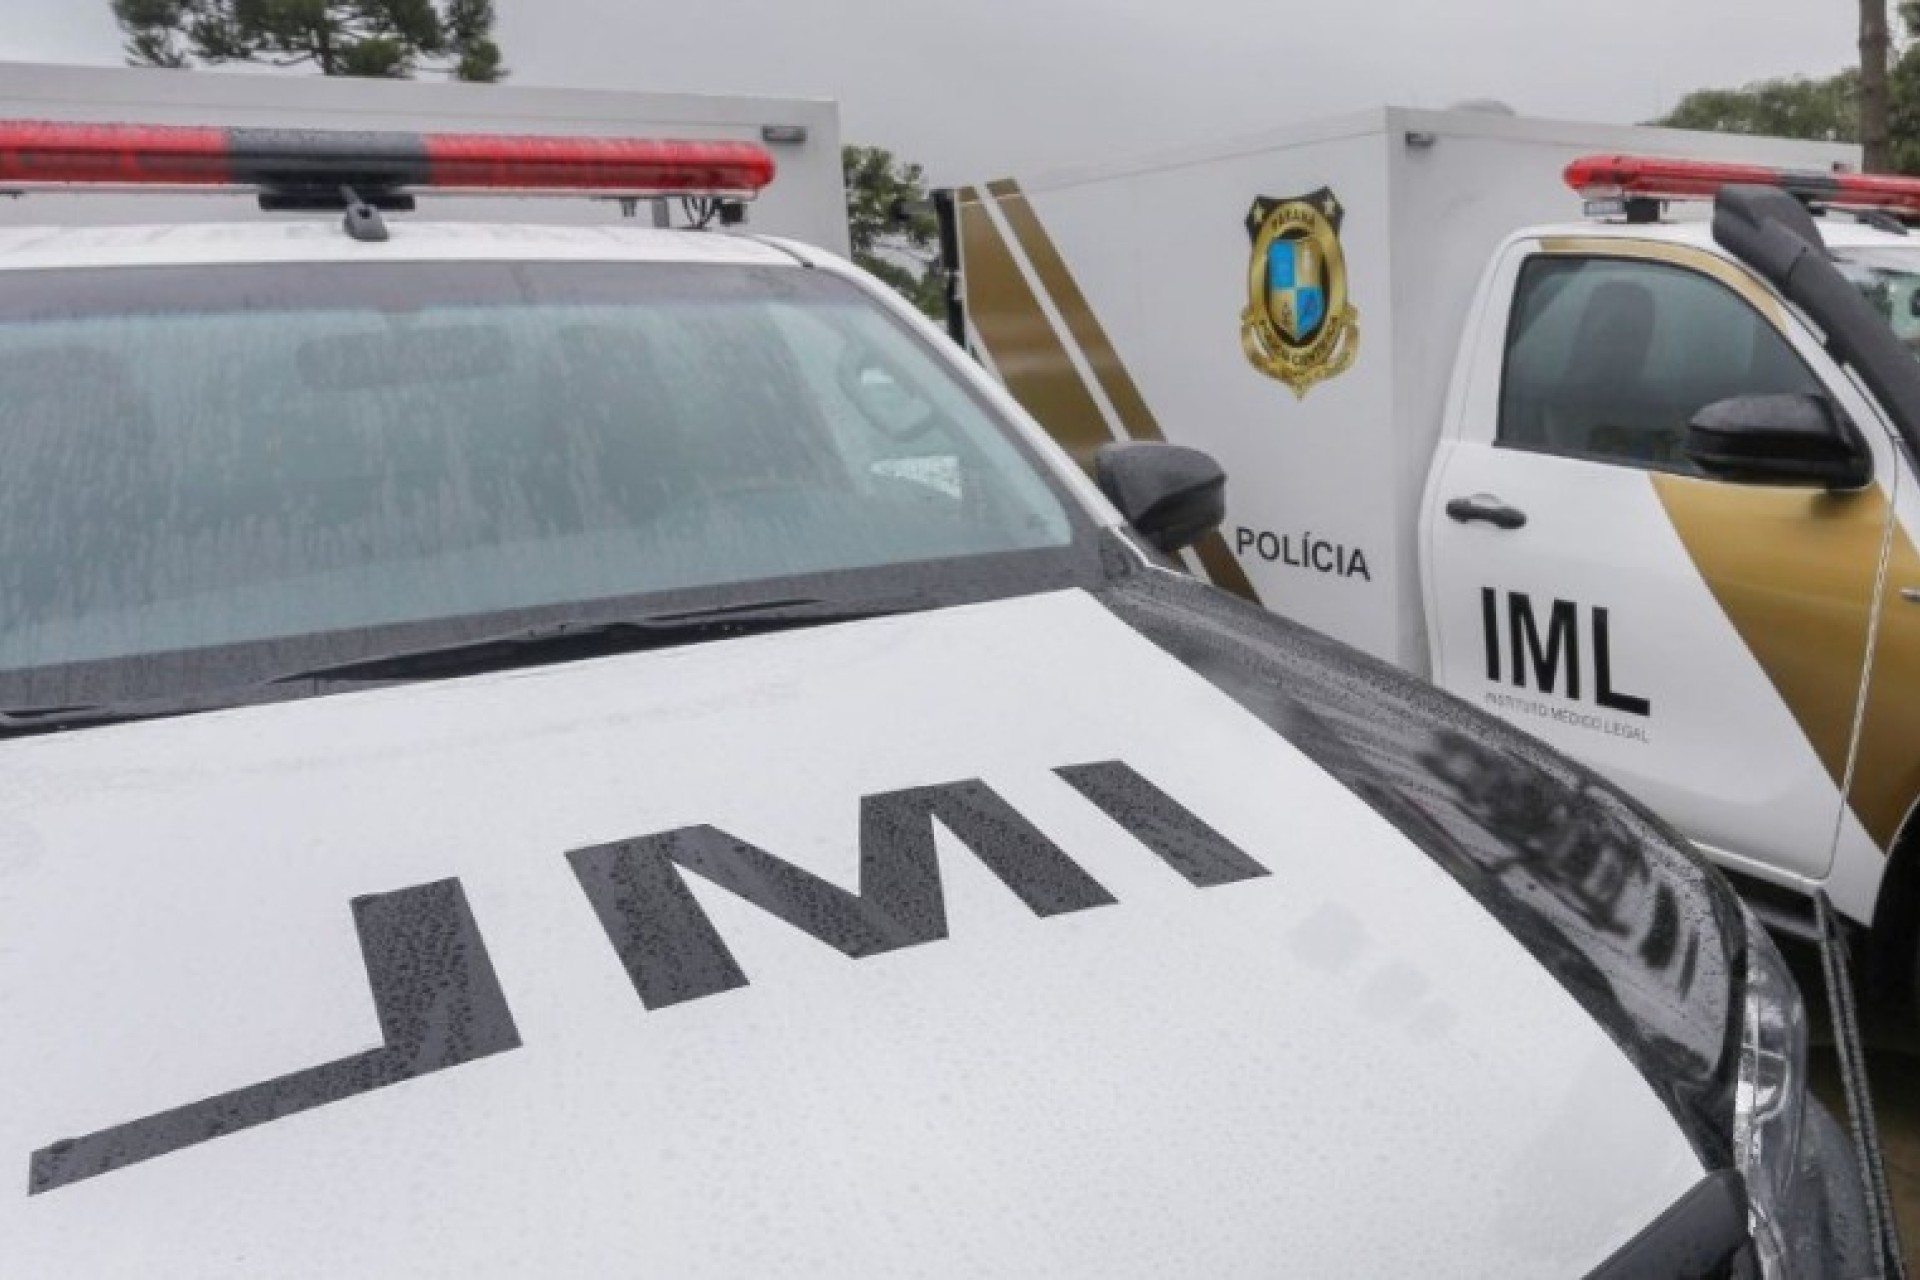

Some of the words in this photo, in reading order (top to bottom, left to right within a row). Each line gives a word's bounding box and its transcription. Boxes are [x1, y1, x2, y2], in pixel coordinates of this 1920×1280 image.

[1236, 526, 1371, 583] POLÍCIA
[1481, 586, 1651, 717] IML
[1604, 718, 1650, 744] LEGAL
